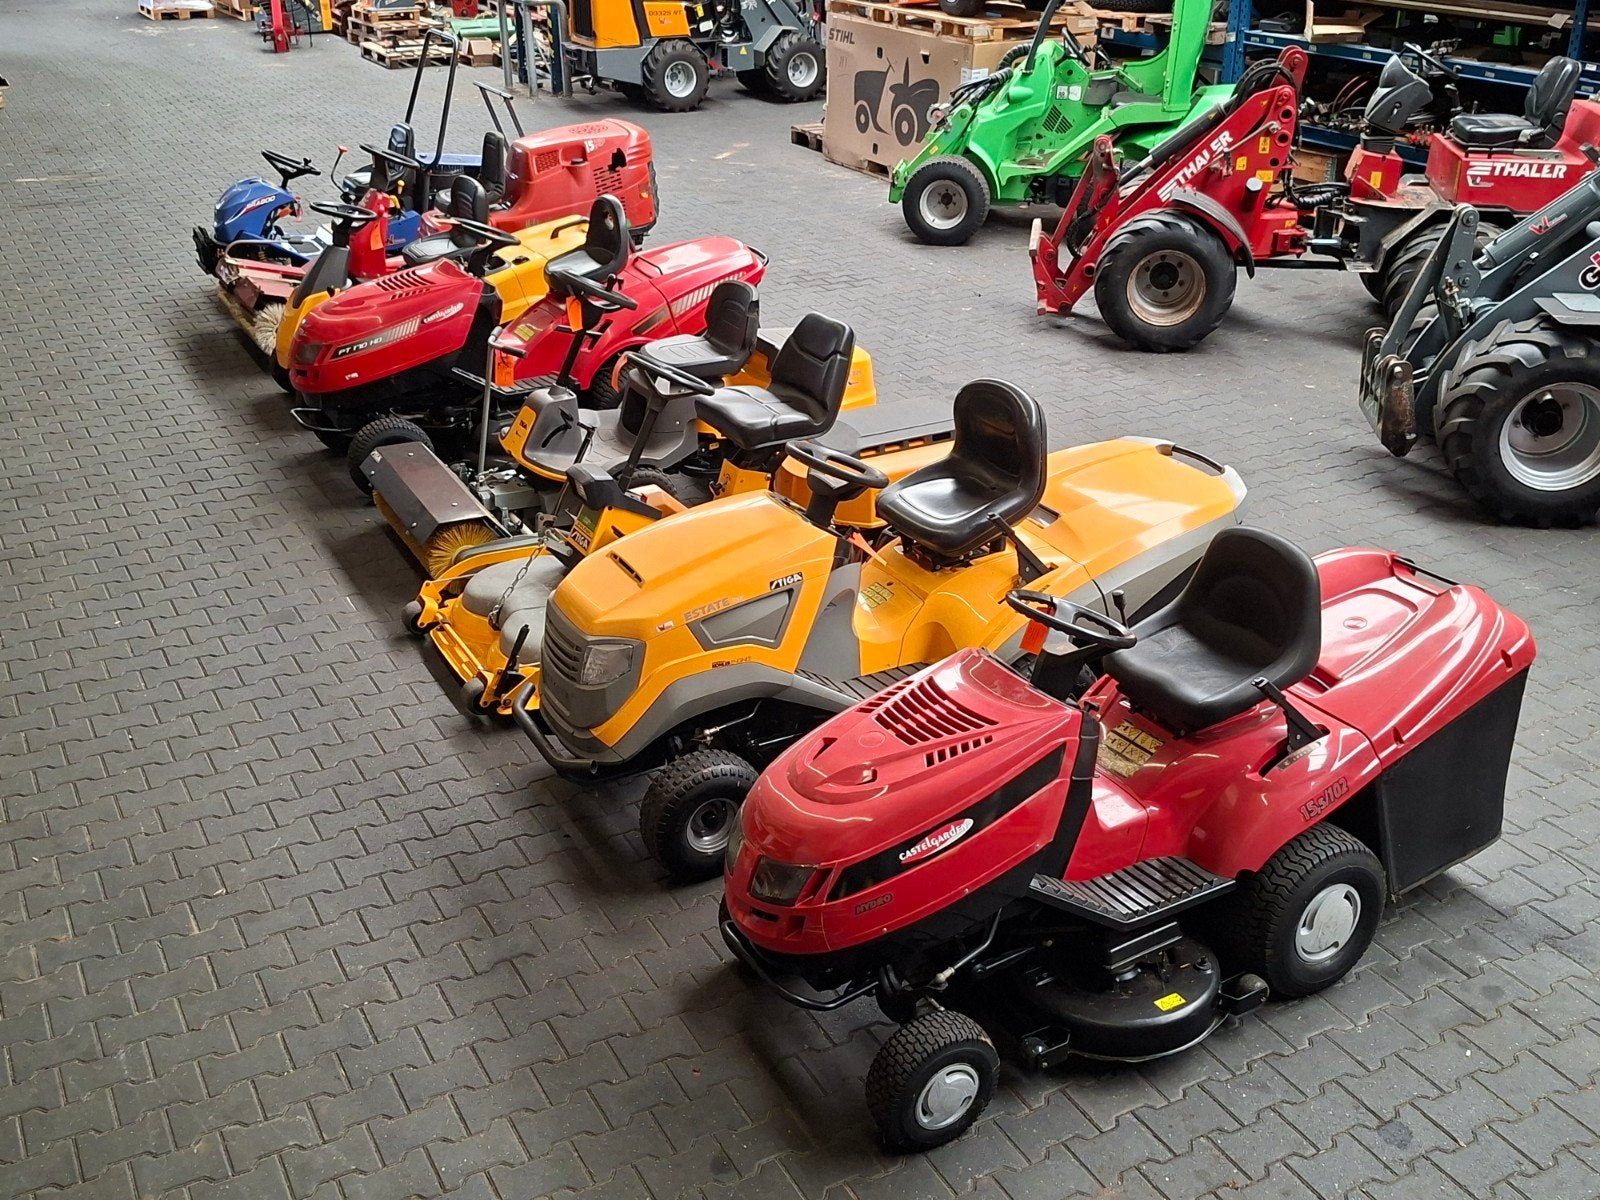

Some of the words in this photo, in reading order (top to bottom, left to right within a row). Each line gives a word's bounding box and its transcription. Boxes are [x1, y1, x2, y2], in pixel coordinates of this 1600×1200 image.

[829, 28, 855, 44] STIHL
[1493, 164, 1567, 178] THALER
[338, 347, 351, 356] PT
[353, 342, 368, 351] 170
[370, 337, 383, 346] HD
[771, 573, 802, 589] STIGA
[683, 597, 730, 621] ESTATE
[1300, 777, 1349, 820] 15,5/102
[856, 894, 892, 914] HYDRO
